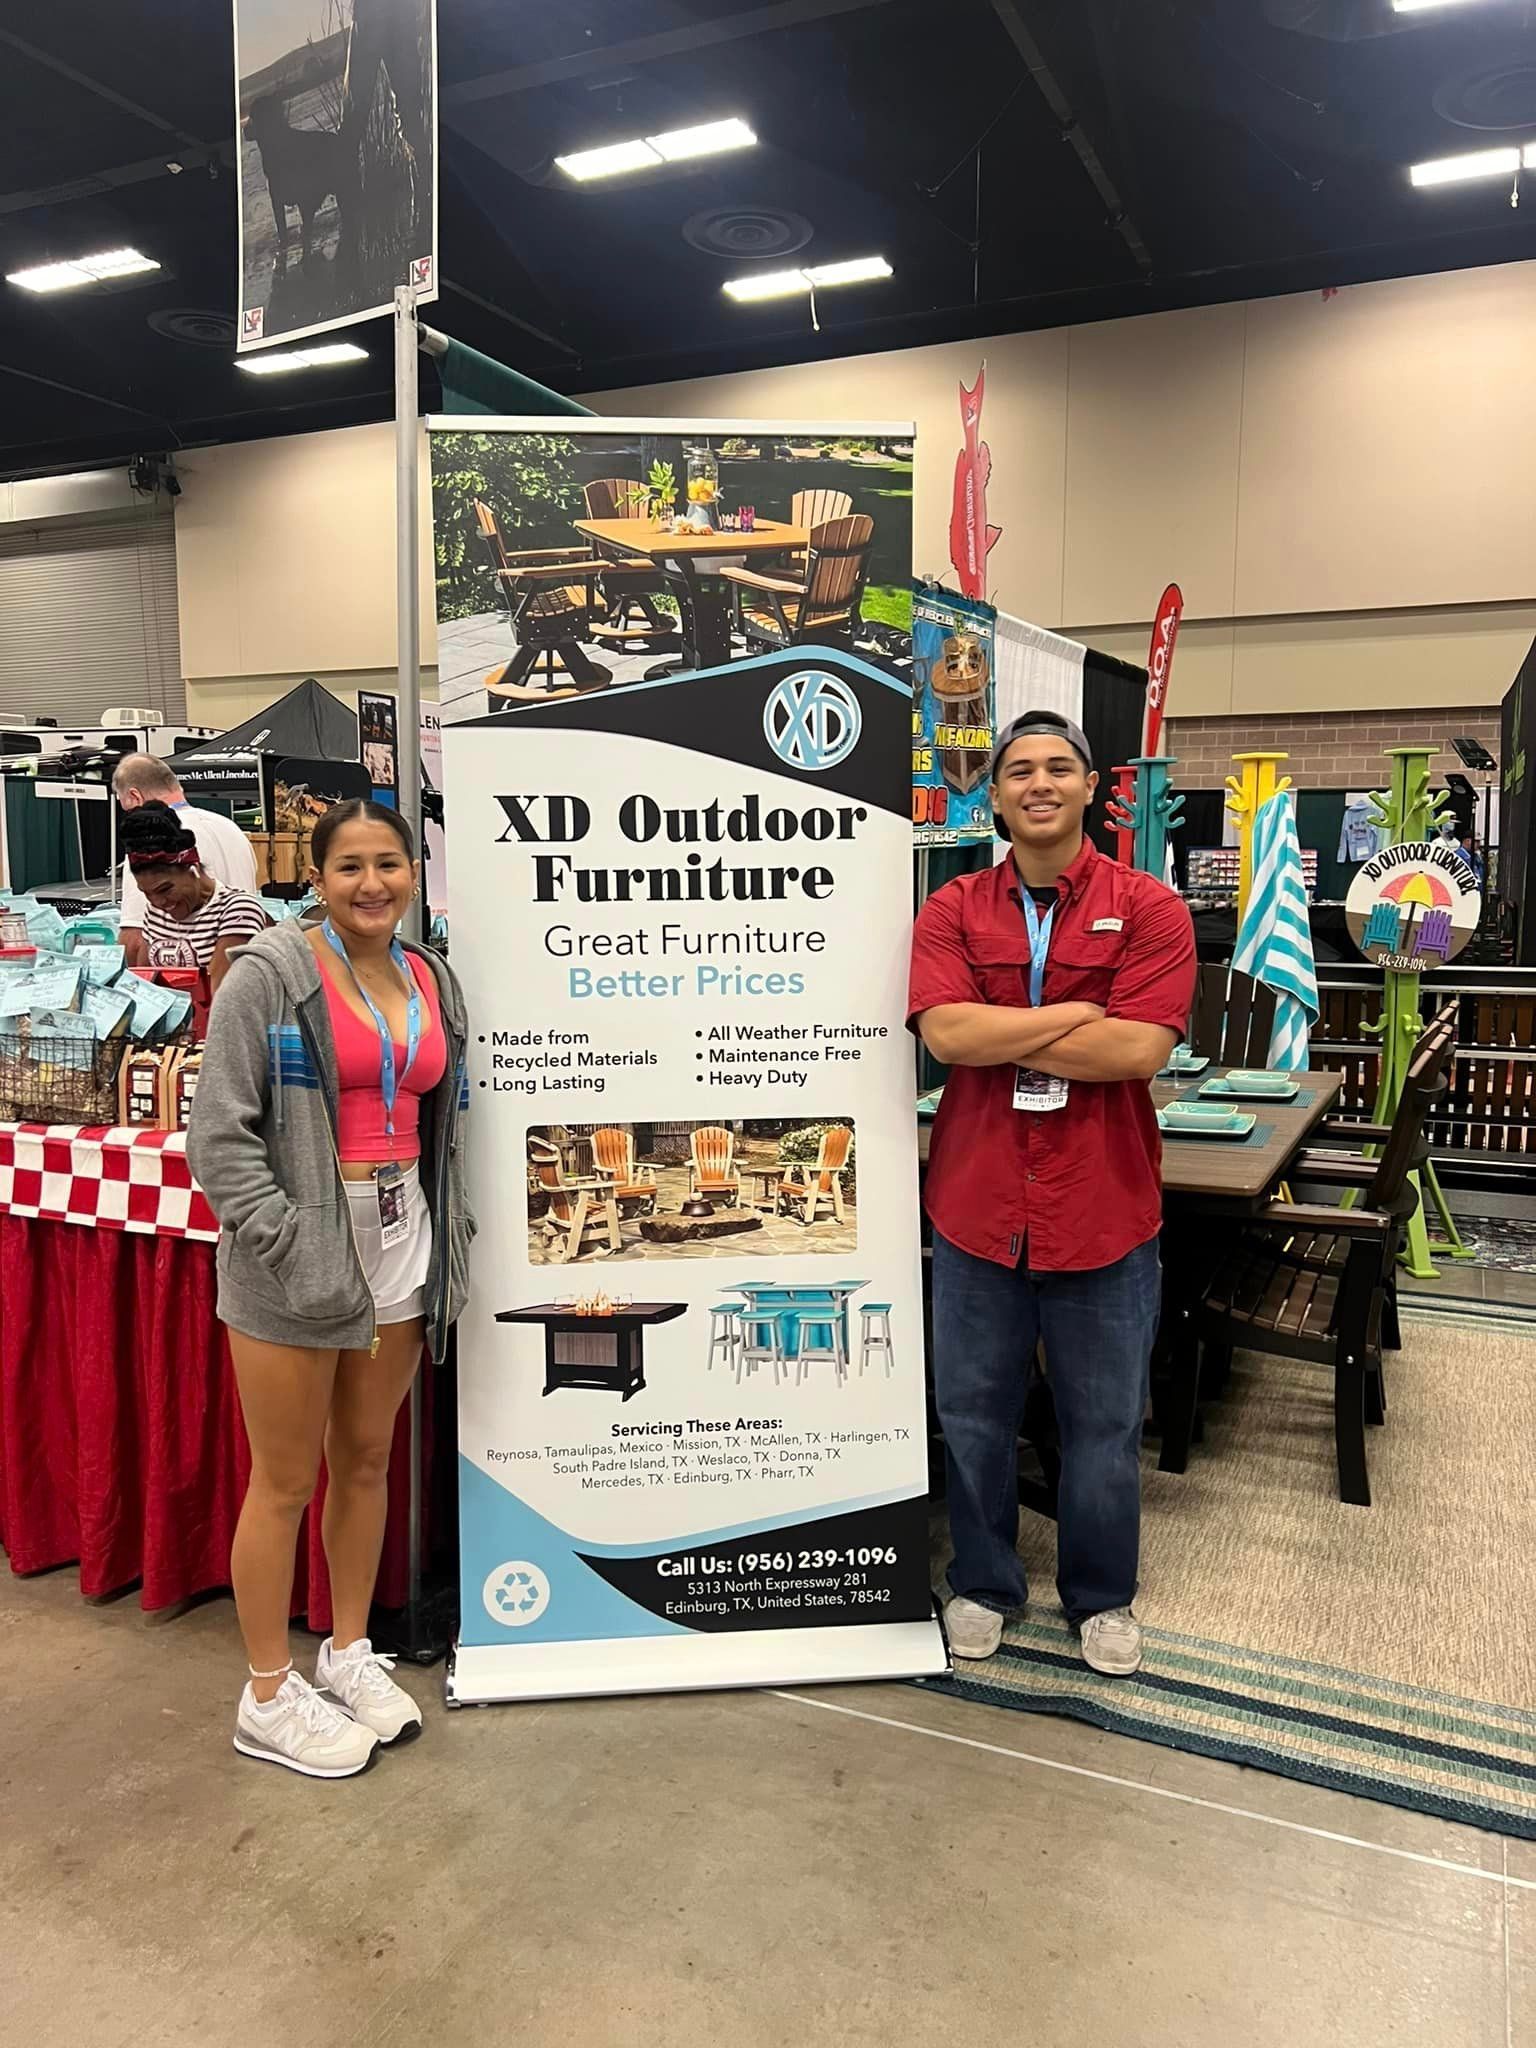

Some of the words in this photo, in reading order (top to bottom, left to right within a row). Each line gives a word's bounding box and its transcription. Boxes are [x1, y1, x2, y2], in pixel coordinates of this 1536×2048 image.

[770, 673, 857, 767] XD
[492, 795, 591, 843] XD
[618, 794, 867, 843] Outdoor
[530, 852, 835, 903] Furniture
[1362, 865, 1383, 882] XD
[1380, 843, 1431, 871] OUTDOOR
[1431, 847, 1479, 896] FURNITURE
[544, 924, 649, 957] Great
[662, 923, 826, 955] Furniture
[569, 967, 685, 998] Better
[697, 964, 805, 996] Prices
[492, 1029, 543, 1047] Made
[547, 1029, 589, 1045] from
[707, 1025, 730, 1041] All
[735, 1024, 809, 1041] Weather
[813, 1023, 889, 1039] Furniture
[492, 1051, 572, 1073] Recycled
[577, 1049, 658, 1067] Materials
[709, 1048, 820, 1064] Maintenance
[824, 1046, 862, 1061] Free
[493, 1076, 537, 1095] Long
[542, 1074, 605, 1093] Lasting
[709, 1070, 763, 1089] Heavy
[767, 1069, 808, 1088] Duty
[611, 1421, 684, 1438] Servicing
[688, 1418, 732, 1433] These
[734, 1417, 783, 1431] Areas:
[486, 1449, 542, 1464] Reynosa,
[544, 1443, 616, 1460] Tamaulipas,
[619, 1441, 664, 1453] Mexico
[673, 1436, 722, 1450] Mission,
[724, 1436, 741, 1448] TX
[750, 1434, 802, 1446] McAllen,
[805, 1432, 821, 1444] TX
[830, 1430, 892, 1445] Harlingen,
[893, 1428, 910, 1440] TX
[553, 1460, 589, 1474] South
[592, 1459, 627, 1472] Padre
[630, 1456, 669, 1470] Island,
[671, 1455, 688, 1467] TX
[697, 1453, 751, 1466] Weslaco,
[753, 1451, 770, 1463] TX
[779, 1450, 823, 1462] Donna,
[824, 1447, 841, 1459] TX
[581, 1475, 645, 1489] Mercedes,
[647, 1473, 664, 1485] TX
[673, 1470, 733, 1485] Edinburg,
[735, 1469, 752, 1480] TX
[761, 1466, 798, 1480] Pharr,
[797, 1465, 814, 1477] TX
[656, 1556, 696, 1577] Call
[700, 1556, 733, 1575] Us:
[738, 1553, 793, 1575] (956)
[798, 1546, 897, 1569] 239-1096
[687, 1580, 721, 1596] 5313
[724, 1578, 762, 1593] North
[765, 1576, 841, 1593] Expressway
[843, 1572, 867, 1586] 281
[665, 1599, 730, 1615] Edinburg,
[732, 1597, 755, 1611] TX,
[757, 1595, 799, 1609] United
[804, 1594, 847, 1608] States,
[849, 1588, 891, 1604] 78542
